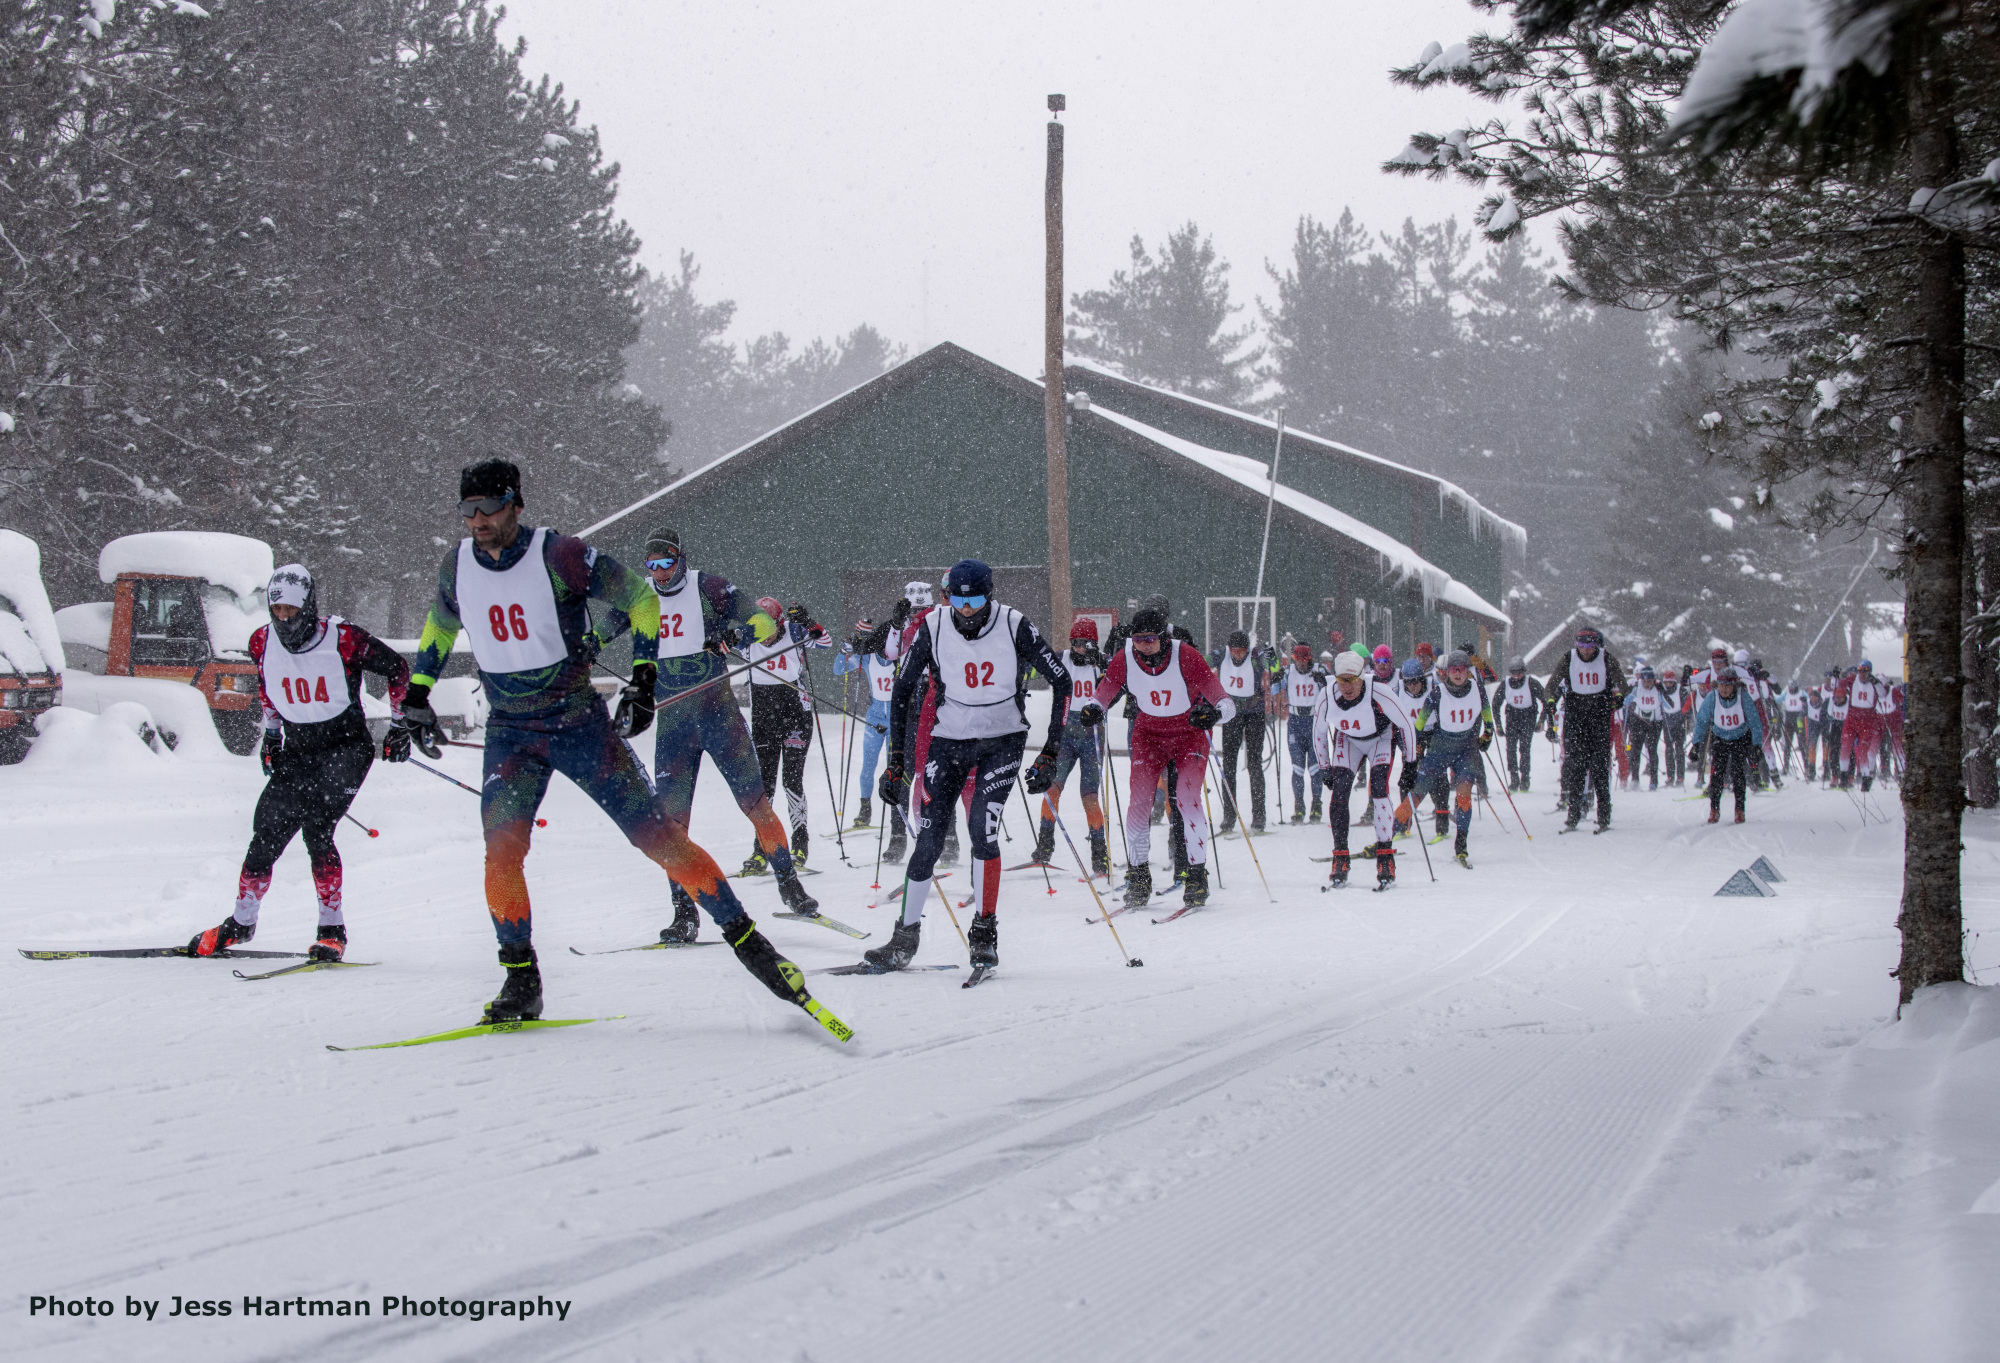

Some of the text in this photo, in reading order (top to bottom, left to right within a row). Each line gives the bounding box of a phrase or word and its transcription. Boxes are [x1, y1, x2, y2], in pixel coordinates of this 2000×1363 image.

[488, 603, 529, 642] 86
[659, 613, 684, 638] 52
[766, 654, 787, 671] 54
[1042, 652, 1065, 678] Audi
[964, 661, 995, 689] 82
[1229, 676, 1244, 688] 79
[1578, 672, 1599, 685] 110
[282, 676, 330, 704] 104
[1296, 684, 1314, 697] 112
[1150, 690, 1172, 706] 87
[1513, 696, 1524, 705] 57
[1641, 696, 1655, 705] 105
[1450, 708, 1473, 723] 111
[1720, 714, 1739, 726] 130
[32, 951, 90, 959] FISCHER
[491, 1022, 523, 1032] FISCHER
